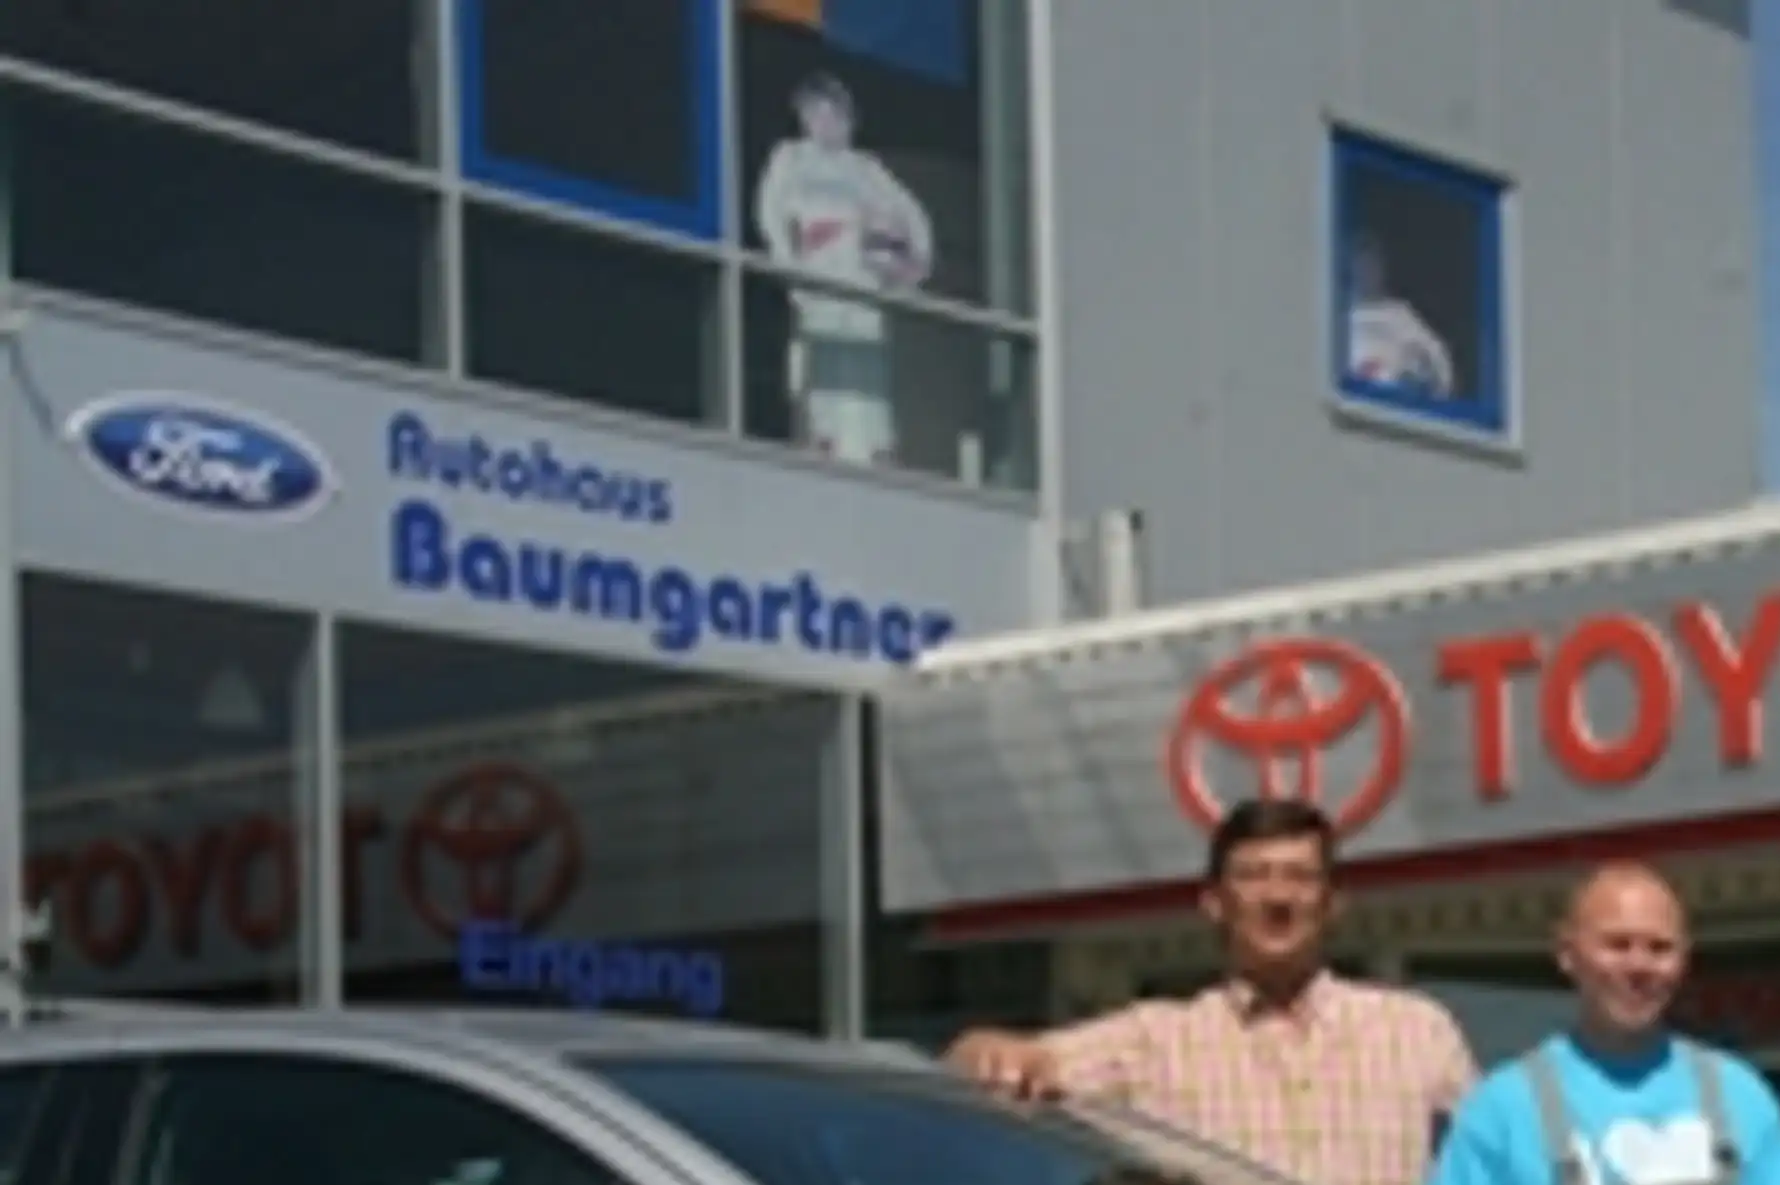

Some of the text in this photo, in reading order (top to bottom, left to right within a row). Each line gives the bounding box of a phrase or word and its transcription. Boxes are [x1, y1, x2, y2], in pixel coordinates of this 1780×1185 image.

[124, 412, 284, 504] Ford
[387, 411, 674, 526] Autohaus
[389, 500, 957, 664] Baumgartner
[459, 920, 724, 1018] Eingang
